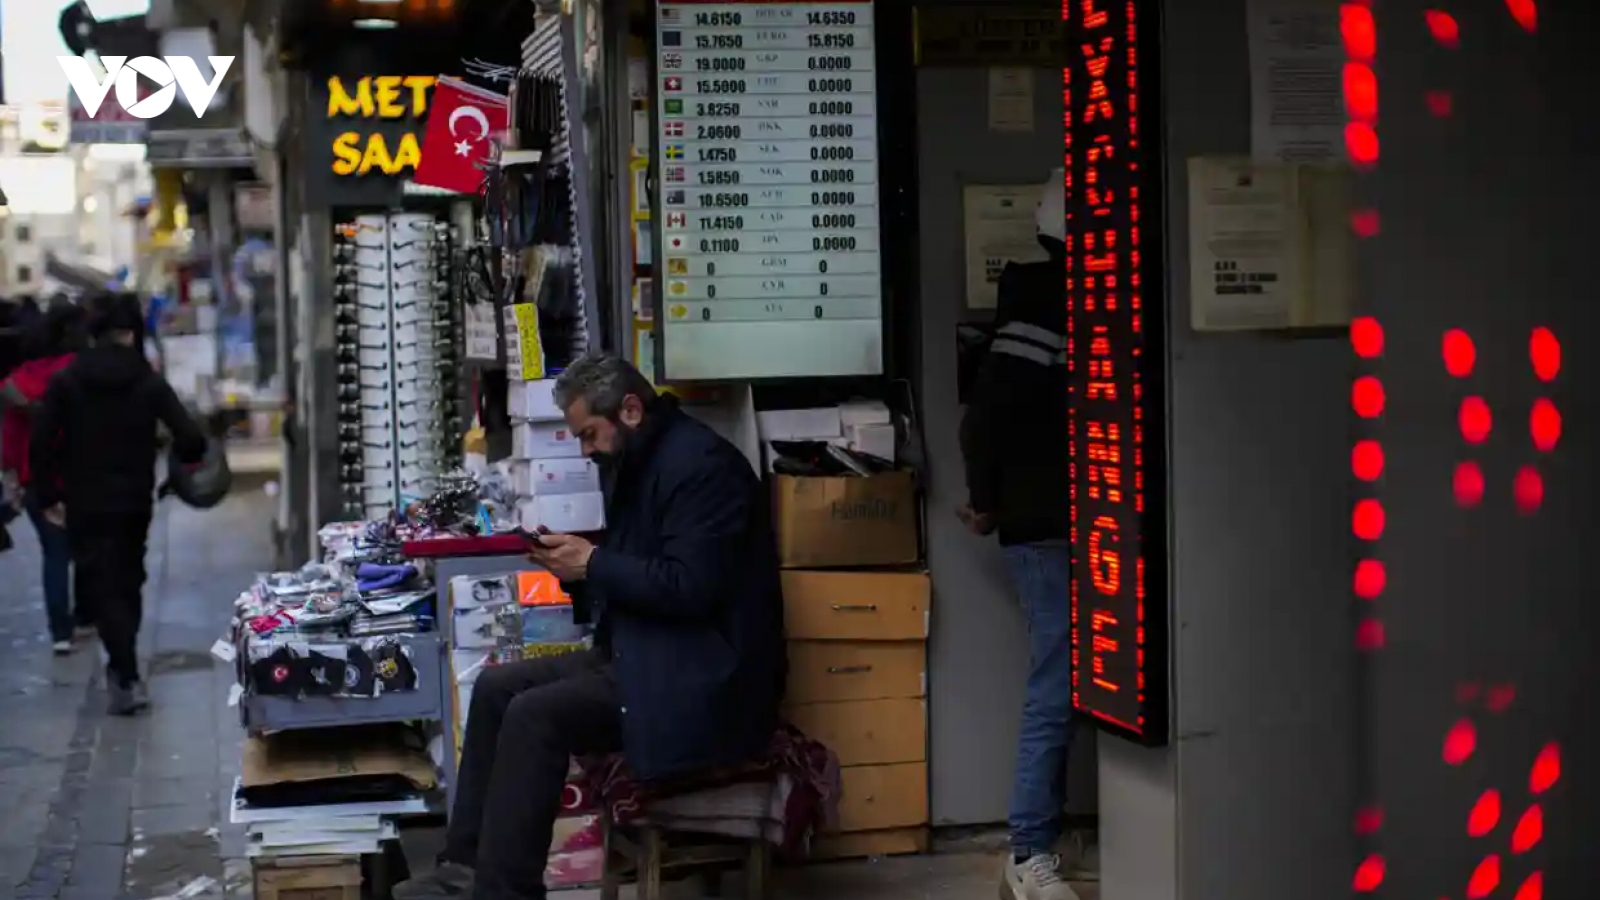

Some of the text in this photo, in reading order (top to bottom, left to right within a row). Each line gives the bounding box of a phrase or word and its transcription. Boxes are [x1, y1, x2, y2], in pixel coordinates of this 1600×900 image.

[695, 11, 742, 27] 14.6150
[807, 11, 855, 26] 14.6350
[695, 34, 743, 49] 15.7650
[807, 33, 854, 49] 15.8150
[696, 57, 746, 72] 19.0000
[807, 56, 852, 71] 0.0000
[696, 79, 746, 94] 15.5000
[808, 78, 852, 93] 0.0000
[696, 102, 740, 117] 3.8250
[808, 101, 853, 116] 0.0000
[697, 125, 741, 140] 2.0600
[809, 124, 853, 138] 0.0000
[698, 147, 737, 162] 1.4750
[810, 146, 854, 161] 0.0000
[698, 167, 854, 185] 1.5850 NOK 0.0000
[698, 192, 749, 208] 10.6500
[811, 191, 855, 206] 0.0000
[700, 213, 856, 230] 11.4150 CAD 0.0000
[699, 238, 740, 253] 0.1100
[812, 236, 856, 251] 0.0000
[706, 262, 716, 277] 0
[818, 259, 828, 274] 0
[707, 284, 716, 299] 0
[819, 282, 828, 296] 0
[702, 307, 711, 322] 0
[814, 305, 823, 319] 0
